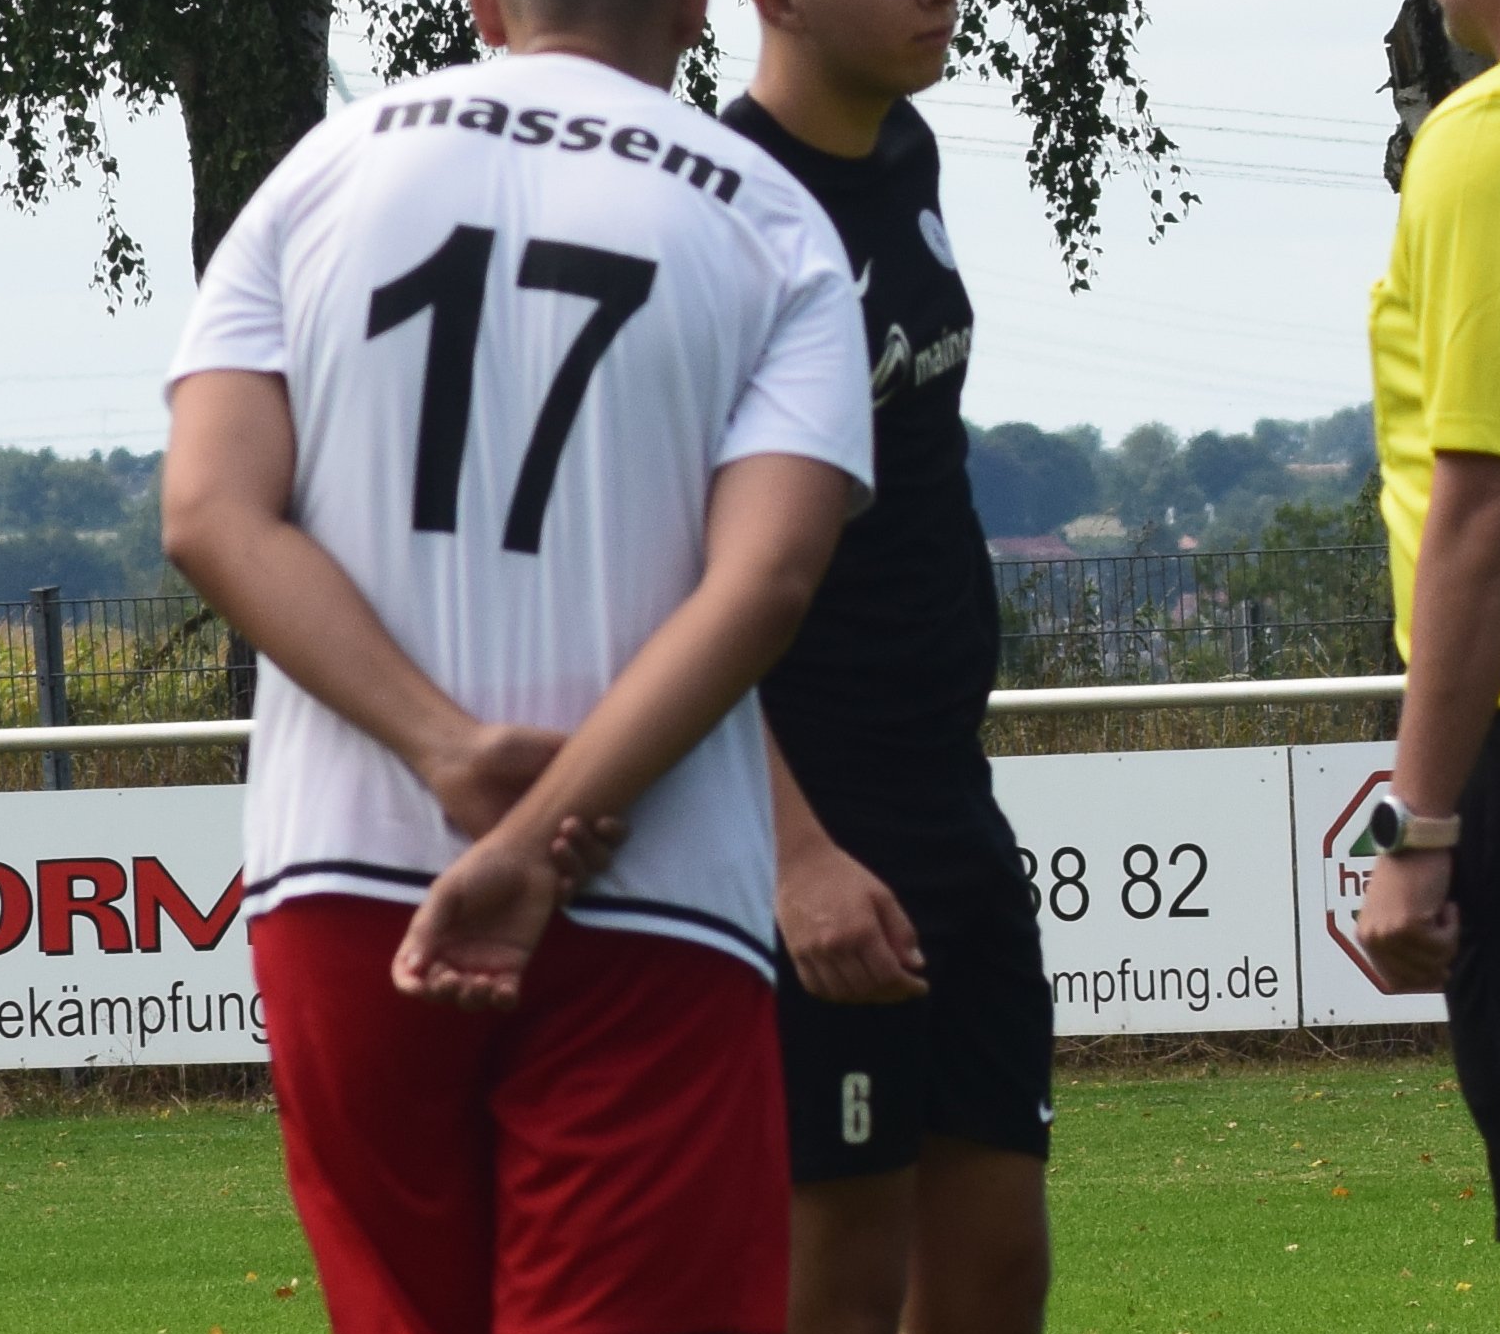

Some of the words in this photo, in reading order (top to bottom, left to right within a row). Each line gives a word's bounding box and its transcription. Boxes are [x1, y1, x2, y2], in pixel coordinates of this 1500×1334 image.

[373, 93, 743, 204] massem
[366, 224, 659, 555] 17
[1121, 843, 1210, 919] 82
[1052, 955, 1279, 1014] mpfung.de
[842, 1071, 871, 1144] 6
